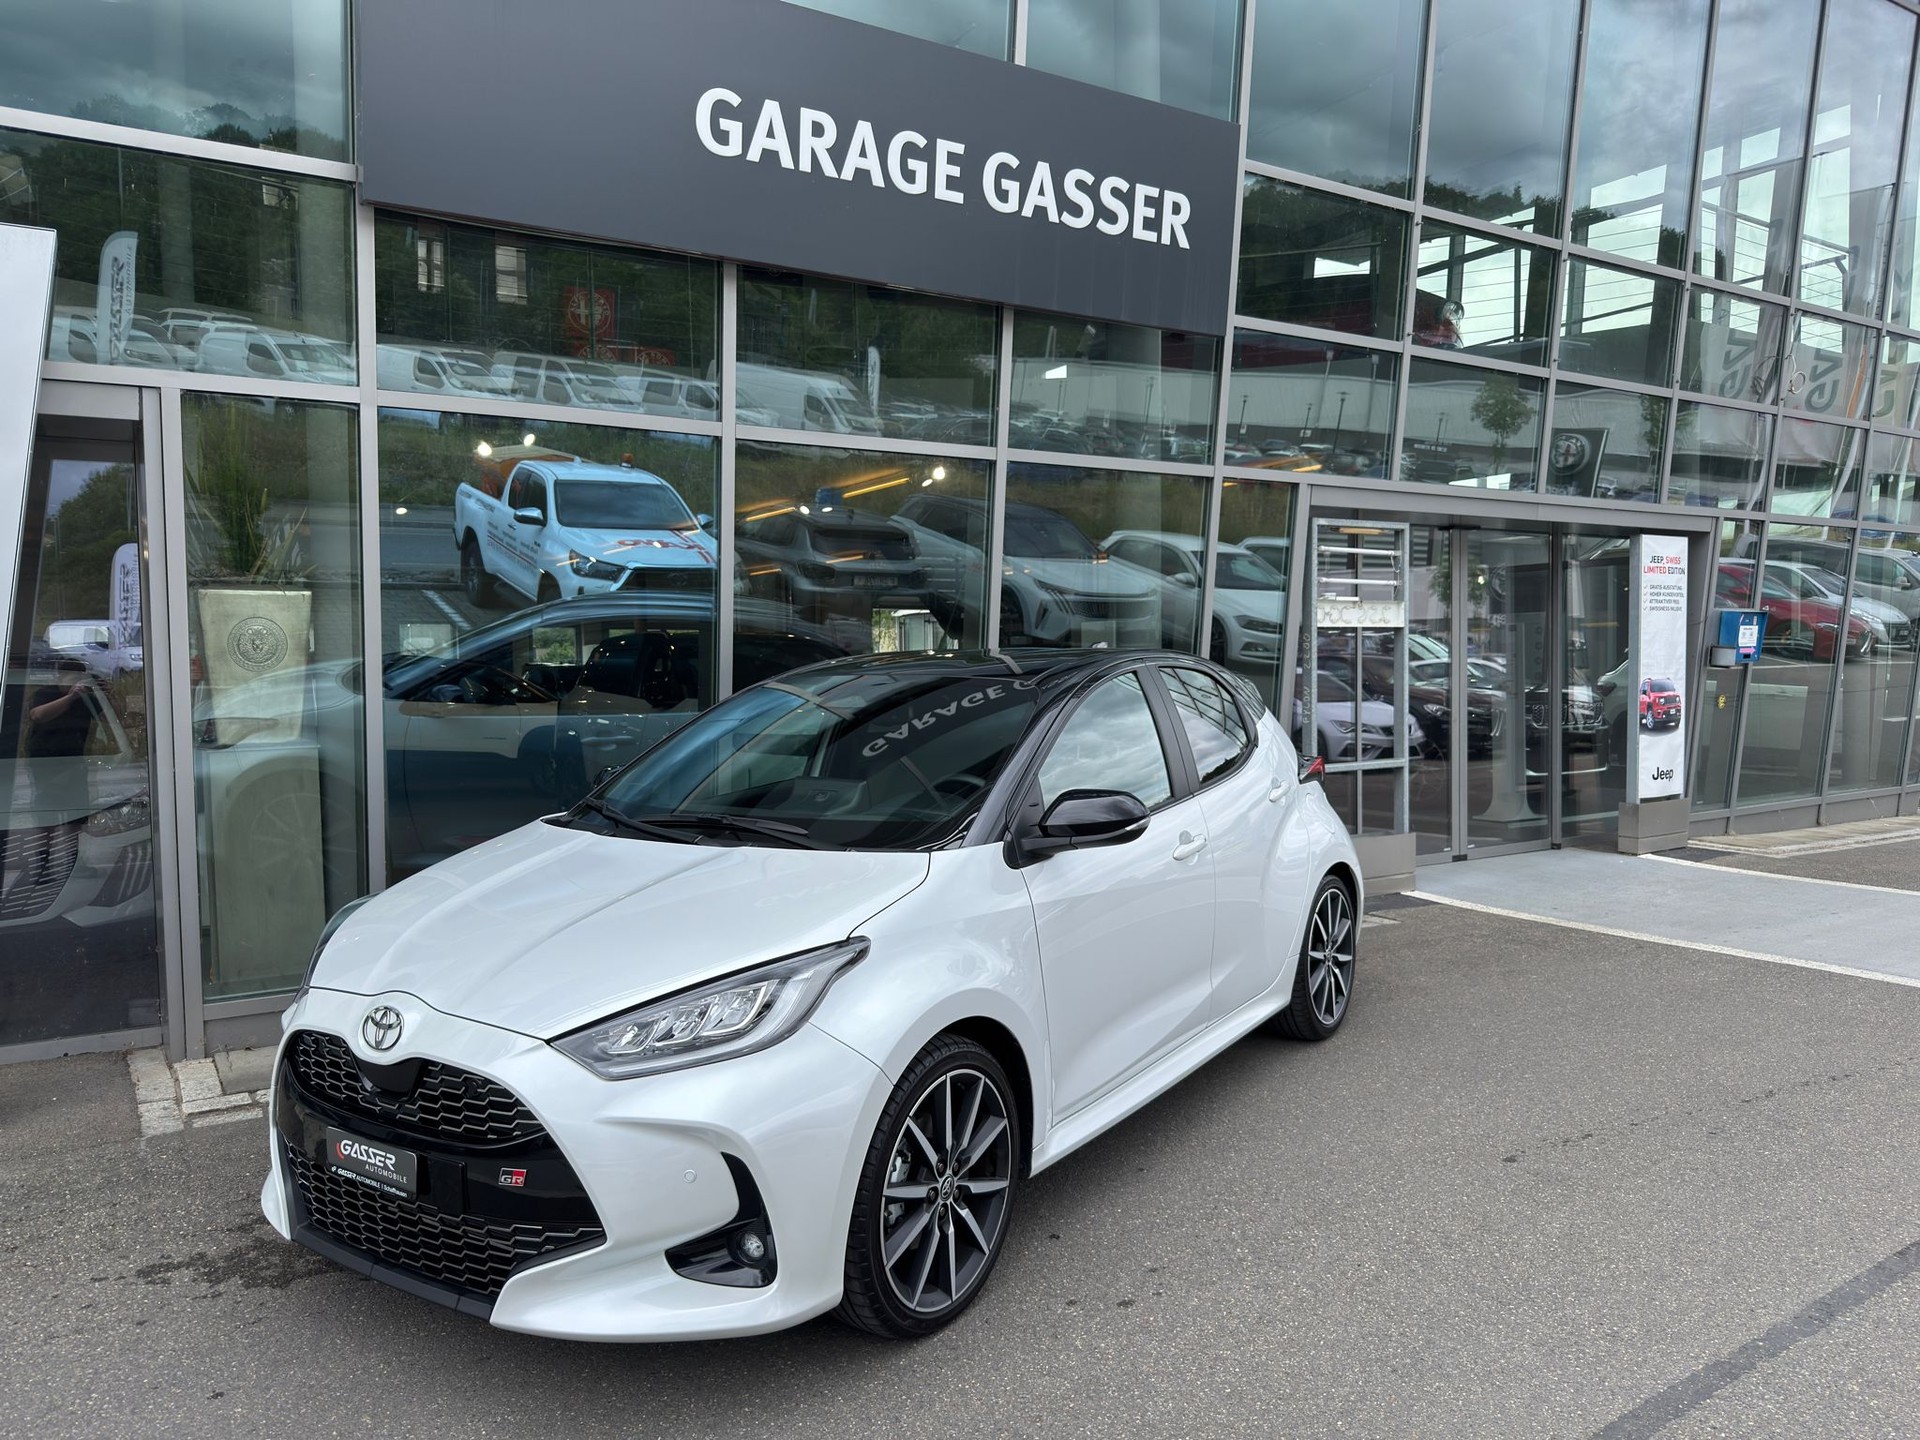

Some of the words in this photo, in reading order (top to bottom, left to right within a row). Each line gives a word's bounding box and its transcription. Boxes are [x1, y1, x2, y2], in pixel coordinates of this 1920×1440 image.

[695, 87, 966, 205] GARAGE
[982, 151, 1191, 249] GASSER
[1665, 556, 1681, 565] SWISS
[1643, 566, 1667, 575] LIMITED
[1668, 566, 1686, 575] EDITION
[1652, 766, 1674, 782] Jeep
[340, 1139, 396, 1172] GASSER
[337, 1167, 357, 1180] GASSER
[356, 1174, 381, 1189] AUTOMOBILE
[365, 1163, 408, 1184] AUTOMOBILE
[500, 1174, 525, 1185] GR
